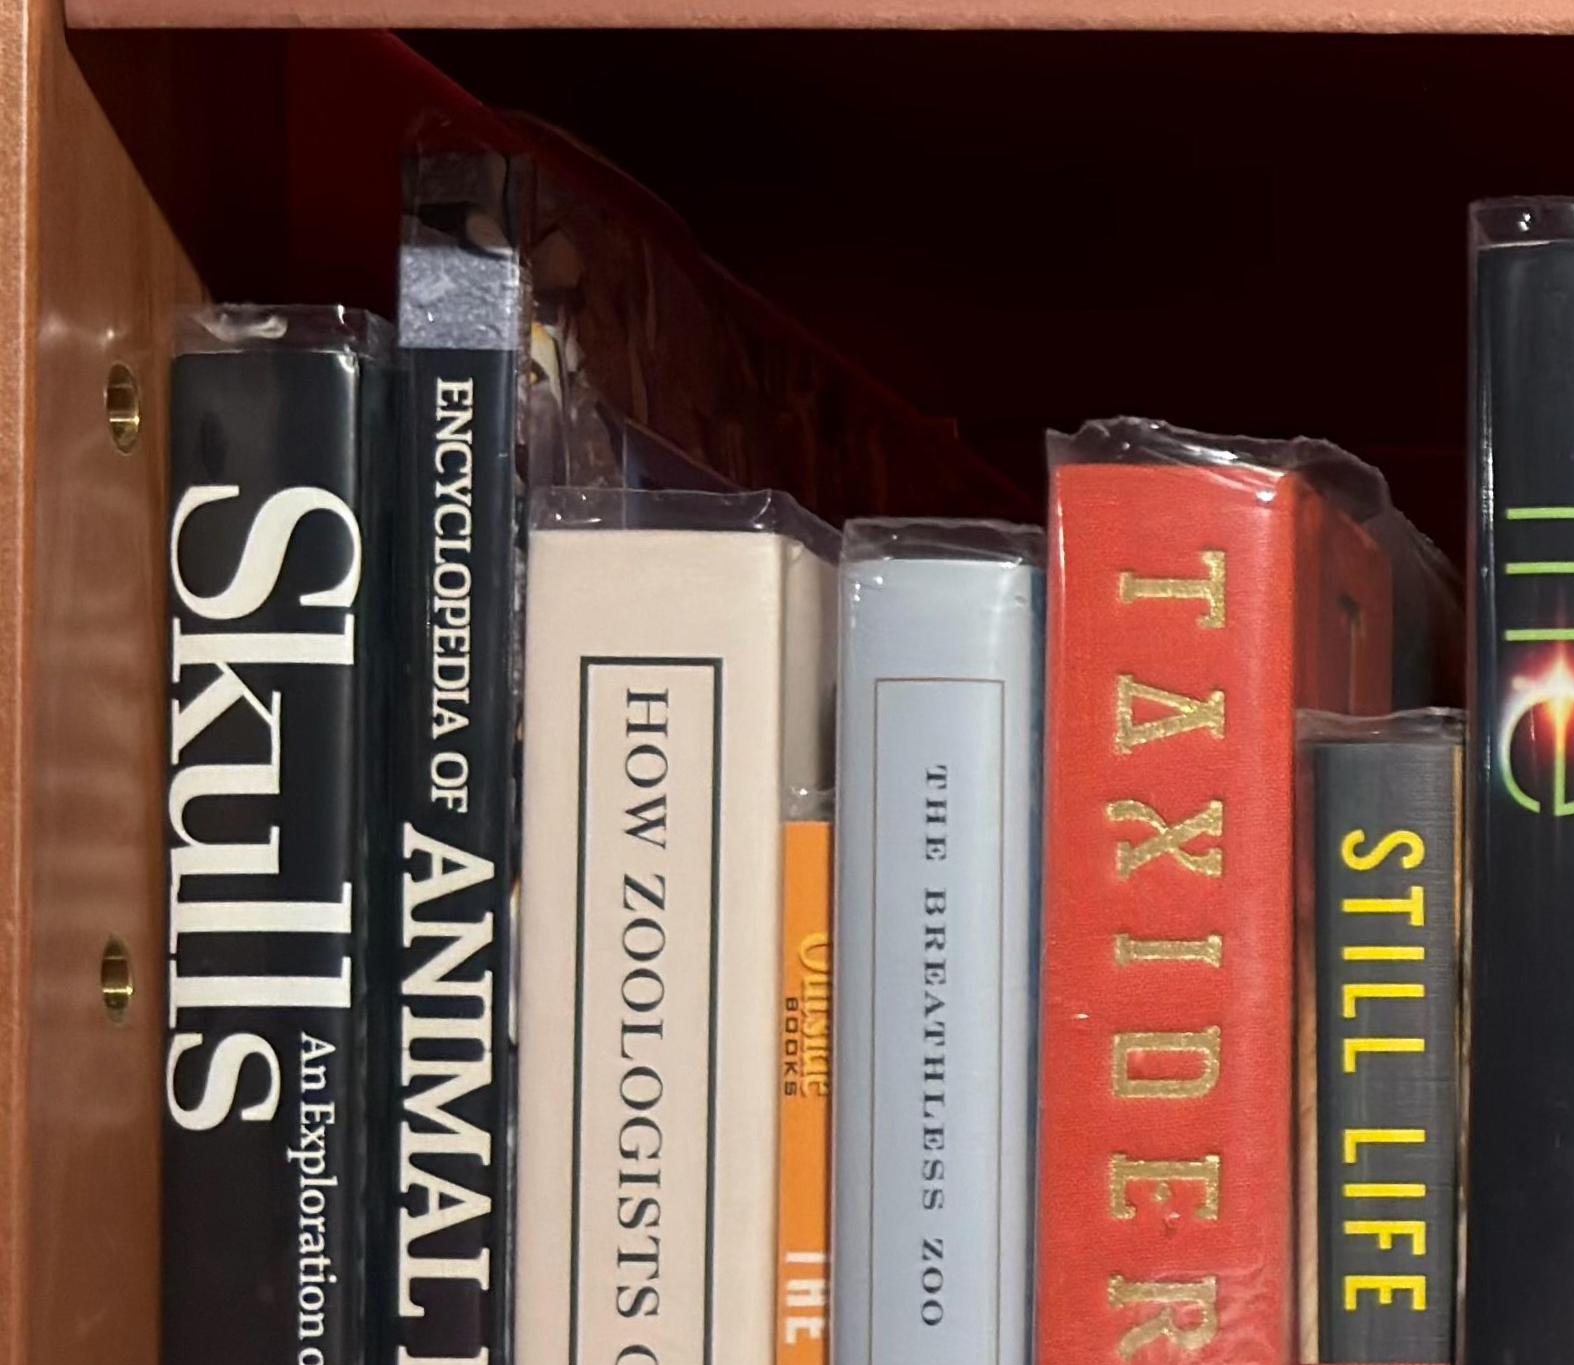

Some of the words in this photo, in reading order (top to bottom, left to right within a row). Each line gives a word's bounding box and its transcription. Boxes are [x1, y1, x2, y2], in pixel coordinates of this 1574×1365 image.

[430, 377, 474, 739] ENCYCLOPEDIA
[166, 484, 363, 1133] Skulls
[430, 752, 469, 813] OF
[624, 688, 669, 850] HOW
[925, 764, 947, 861] THE
[1341, 829, 1425, 1073] STILL
[300, 1032, 337, 1093] An
[398, 822, 495, 1317] ANIMAL
[616, 873, 666, 1319] ZOOLOGISTS
[784, 996, 799, 1097] BOOKS
[922, 890, 946, 1210] BREATHLESS
[289, 1101, 338, 1340] Exploration
[784, 1249, 830, 1345] THE
[921, 1237, 944, 1327] ZOO
[1343, 1128, 1426, 1311] LIFE
